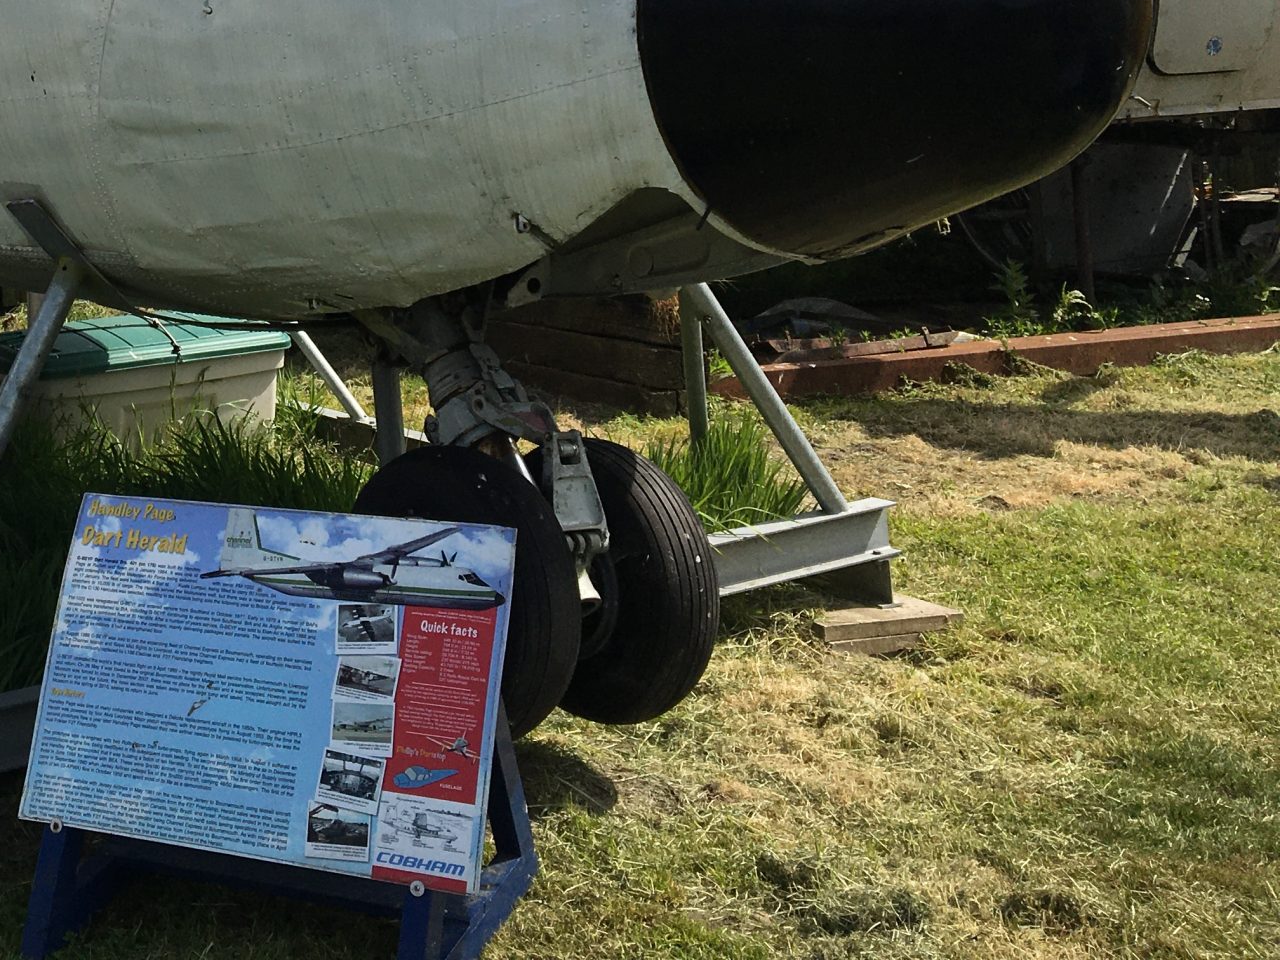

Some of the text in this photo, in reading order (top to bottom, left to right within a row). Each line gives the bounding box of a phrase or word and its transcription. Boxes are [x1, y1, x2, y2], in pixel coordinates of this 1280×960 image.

[90, 499, 174, 523] Handley Page
[81, 525, 188, 555] Dart Herald
[420, 620, 478, 638] Quick facts
[376, 852, 465, 876] COBHAM
